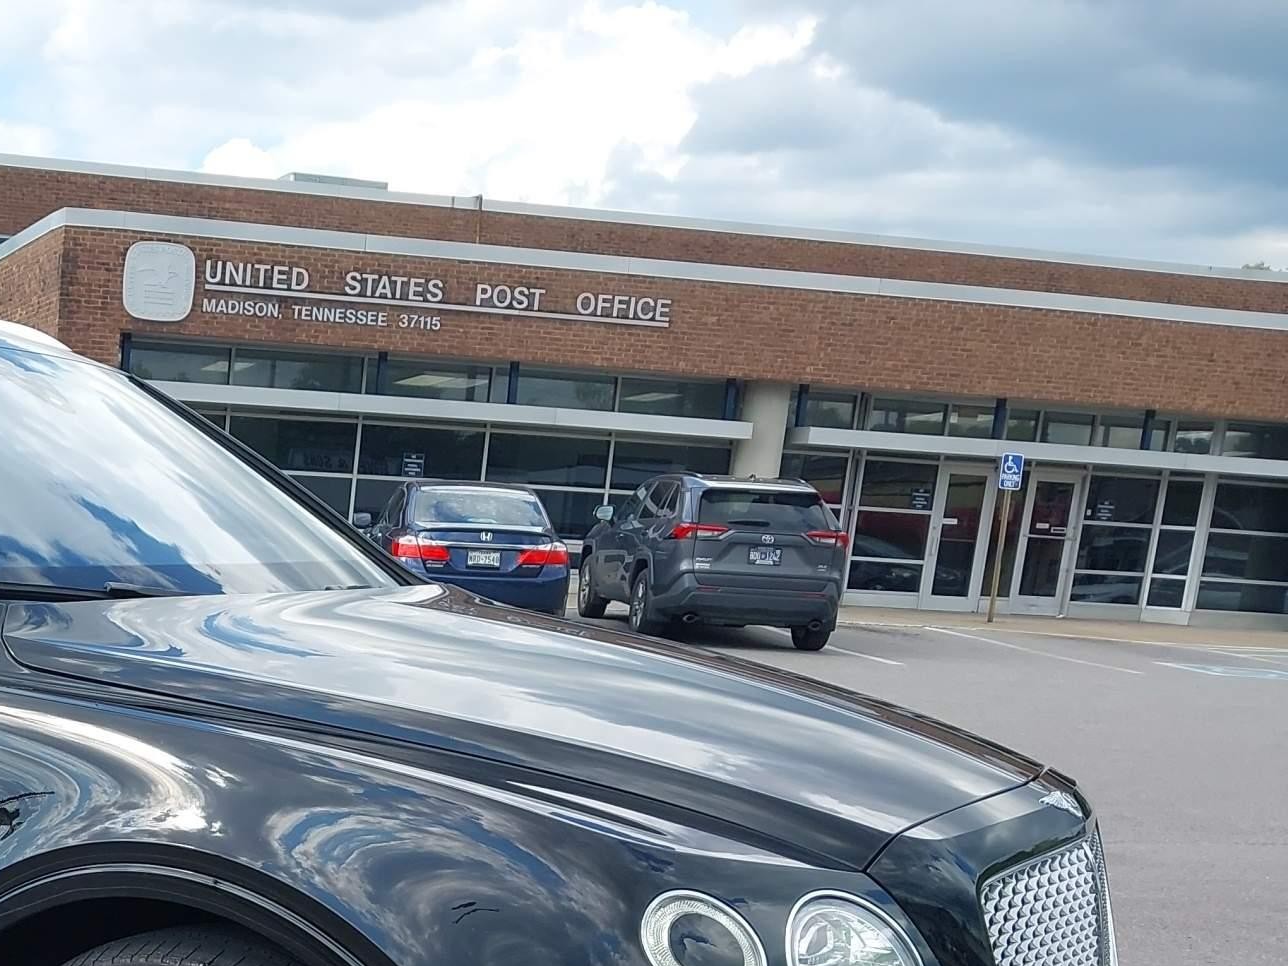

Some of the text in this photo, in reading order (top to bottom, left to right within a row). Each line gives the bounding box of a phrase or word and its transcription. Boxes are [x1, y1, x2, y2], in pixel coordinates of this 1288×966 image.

[202, 298, 441, 330] MADISON, TENNESSEE 37115
[205, 259, 309, 291] UNITED
[344, 271, 443, 302] STATES
[475, 283, 546, 311] POST
[576, 292, 672, 322] OFFICE
